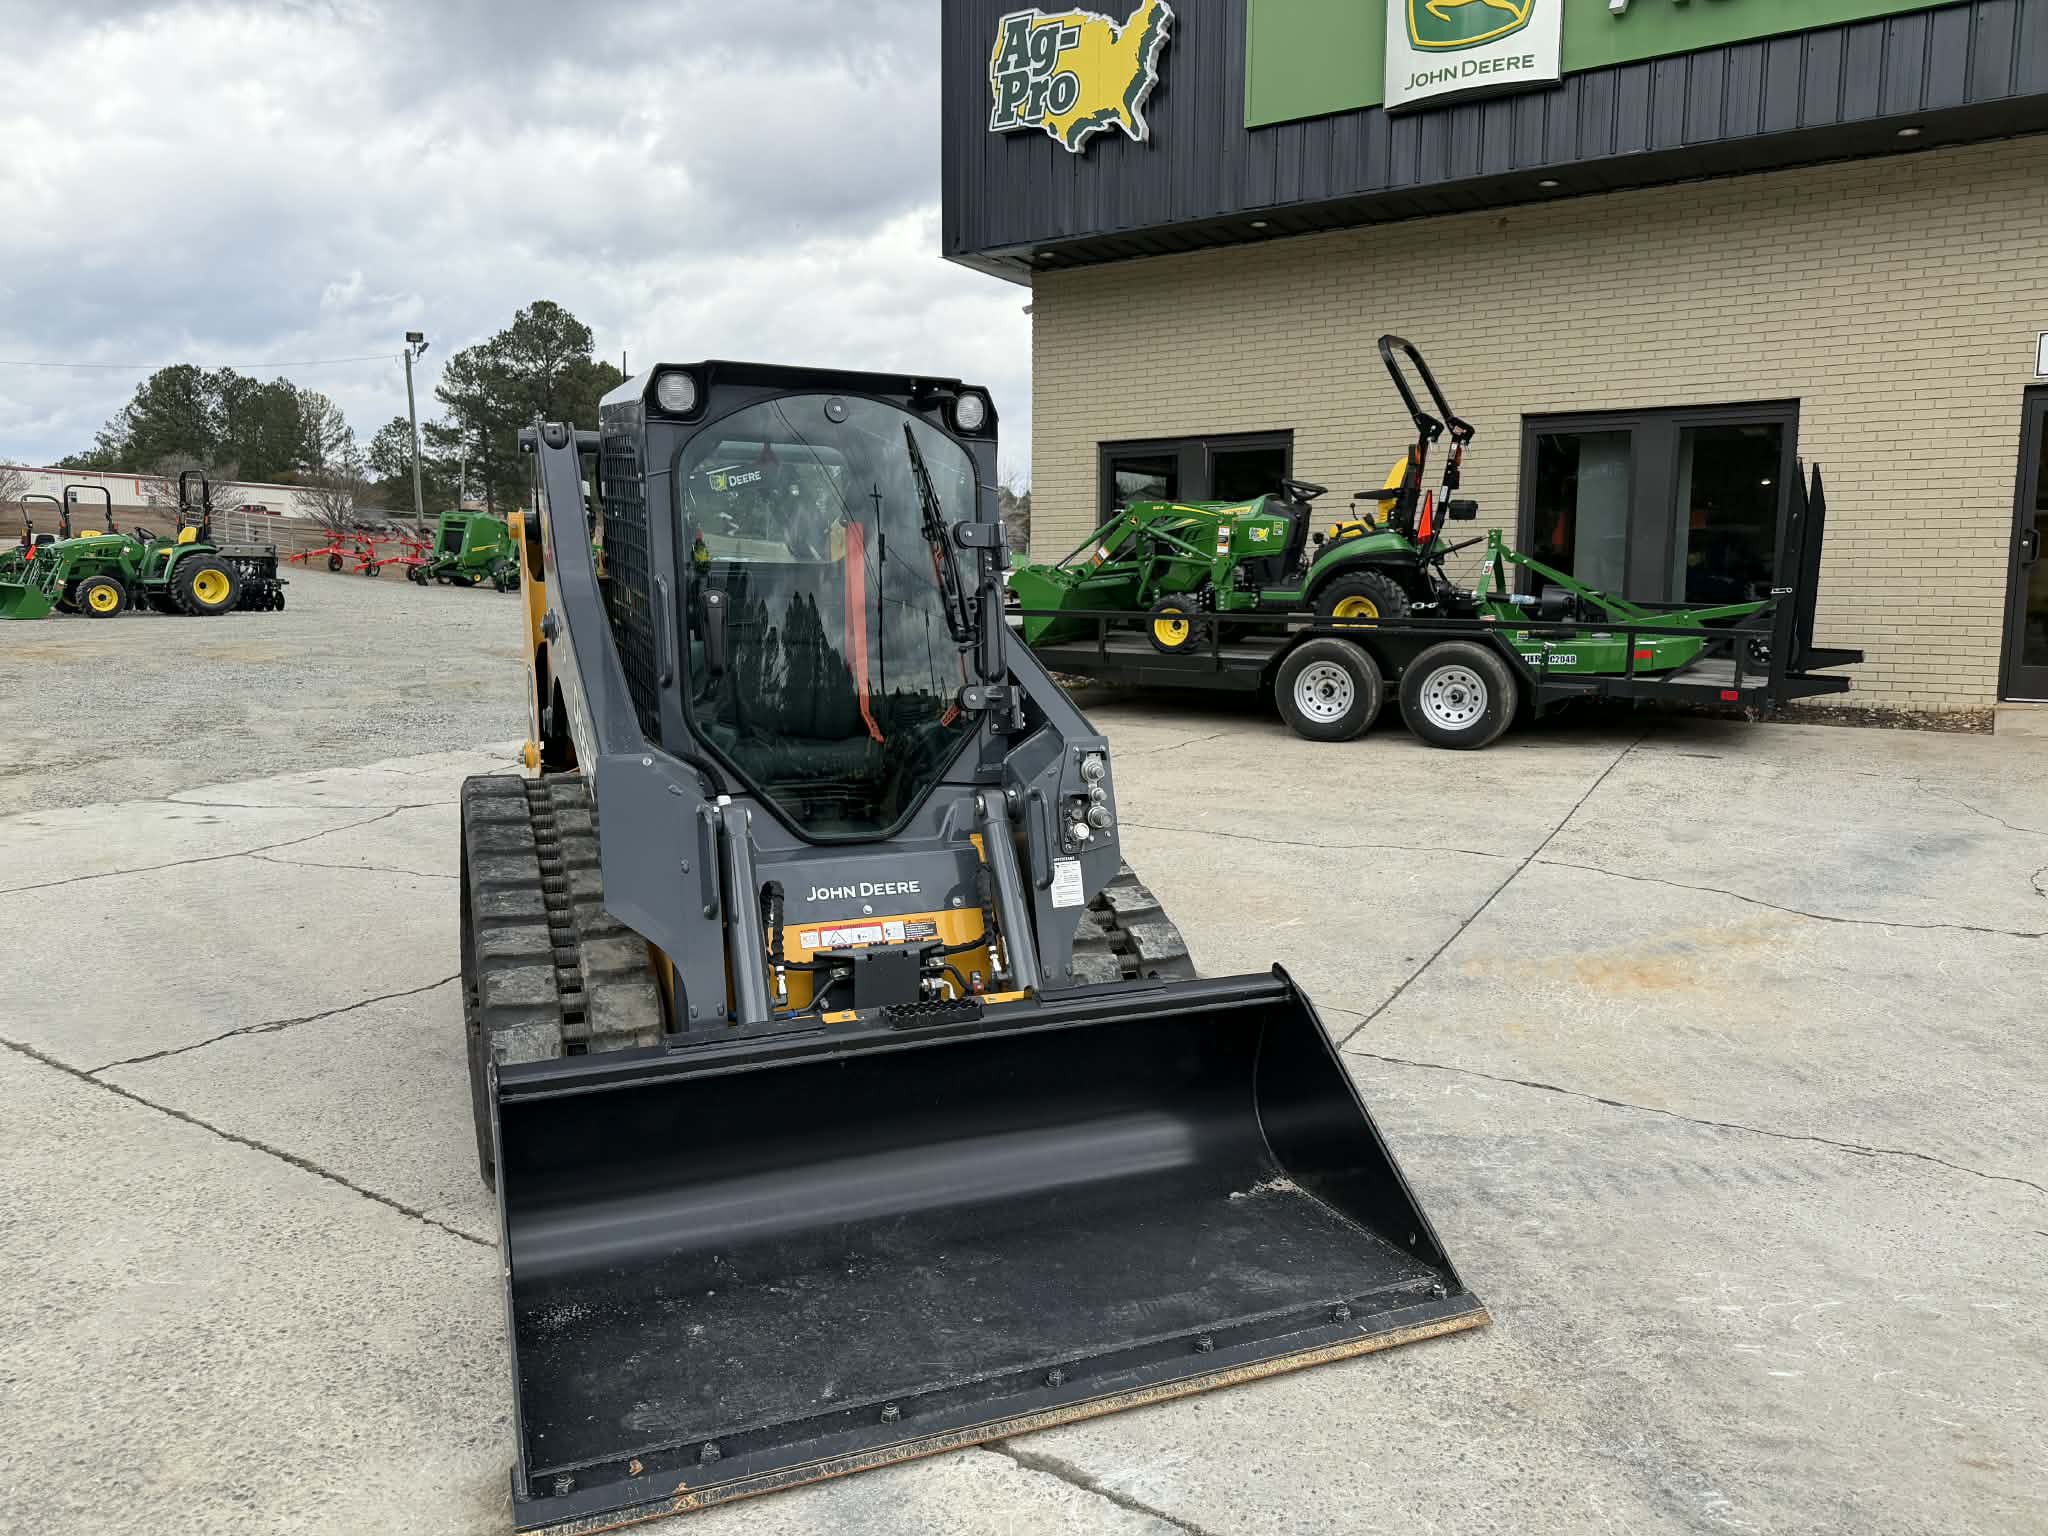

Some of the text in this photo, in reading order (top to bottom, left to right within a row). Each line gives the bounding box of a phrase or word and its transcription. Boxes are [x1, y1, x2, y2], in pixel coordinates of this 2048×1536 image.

[995, 15, 1080, 79] Ag-
[1404, 54, 1536, 91] JOHN DEERE
[989, 70, 1080, 131] Pro
[728, 471, 761, 487] DEERE
[1548, 654, 1577, 665] C2048
[806, 880, 921, 902] JOHN DEERE
